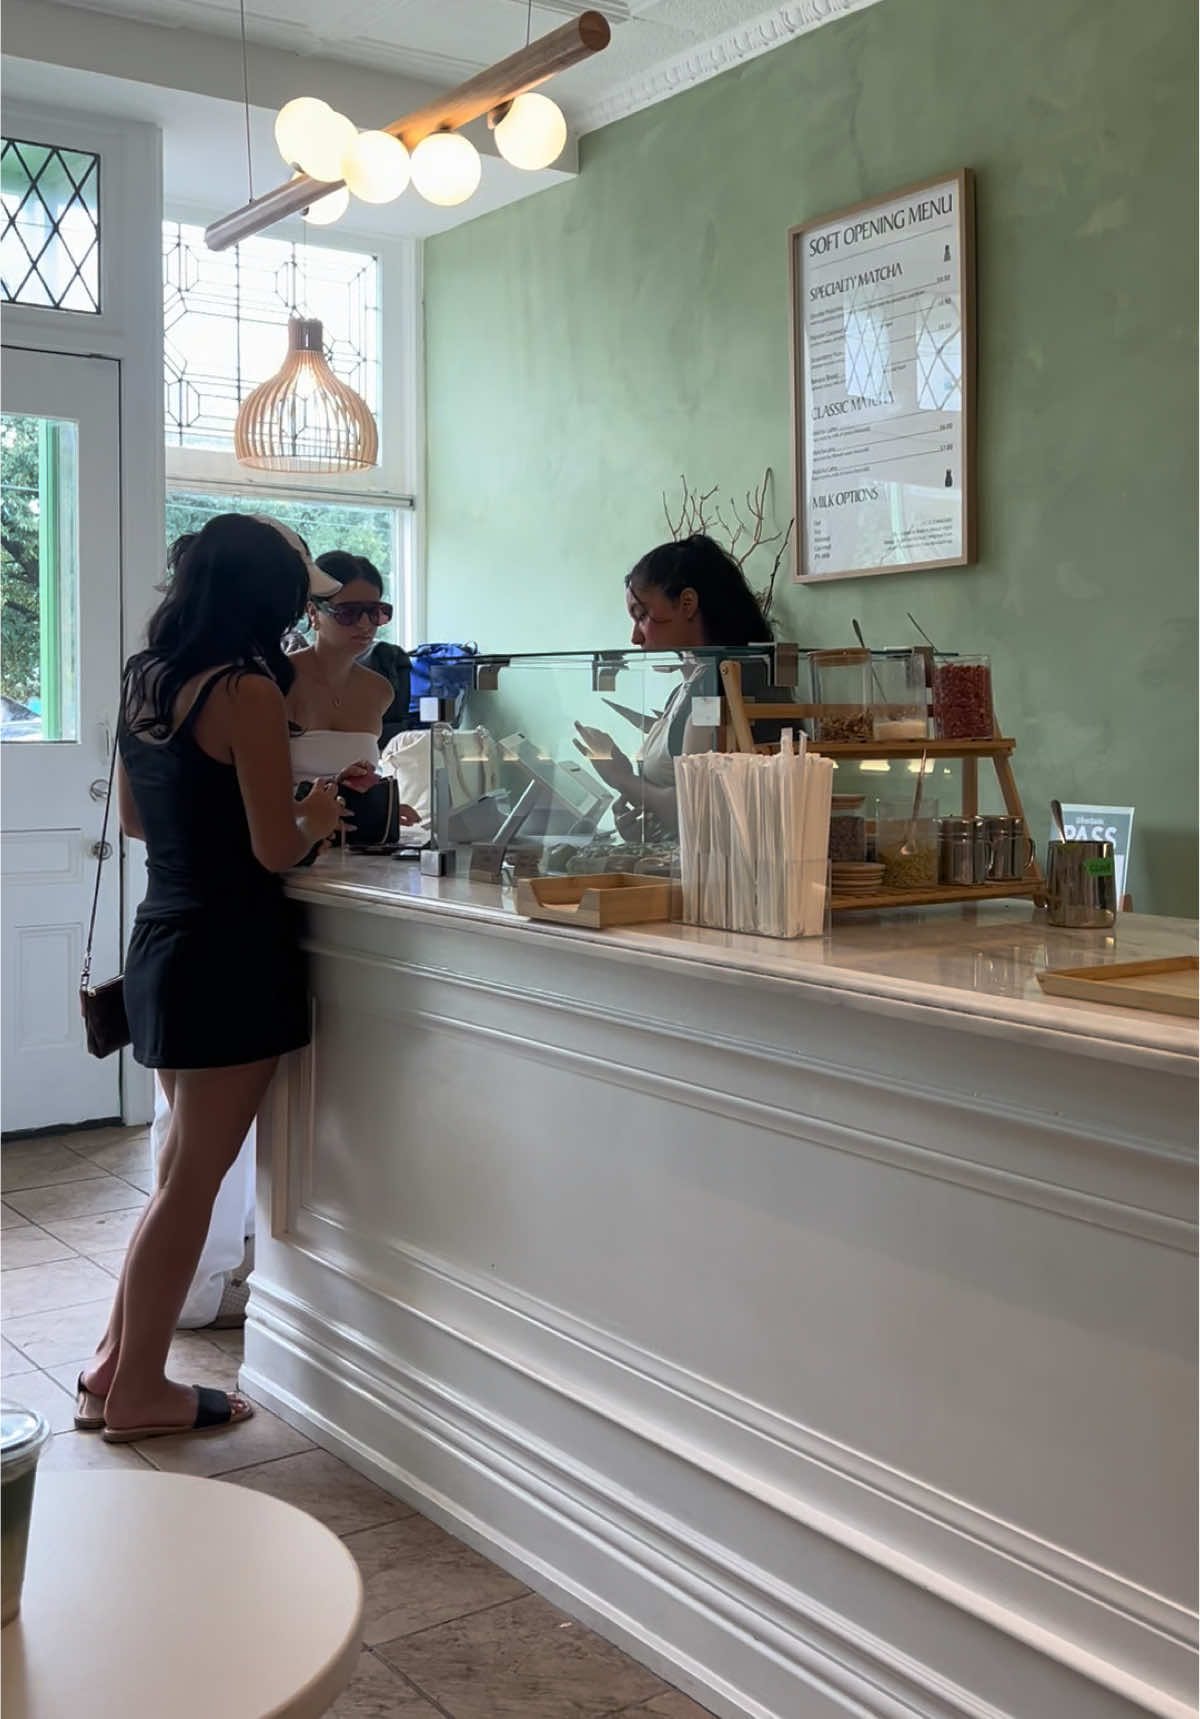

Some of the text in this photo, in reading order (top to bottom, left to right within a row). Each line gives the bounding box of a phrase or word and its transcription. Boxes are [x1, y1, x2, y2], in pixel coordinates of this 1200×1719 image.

[809, 193, 953, 258] SOFT OPENING MENU
[809, 262, 904, 302] SPECIALTY MATCHA
[811, 398, 849, 421] CLASSIC
[811, 487, 880, 511] MILK OPTIONS
